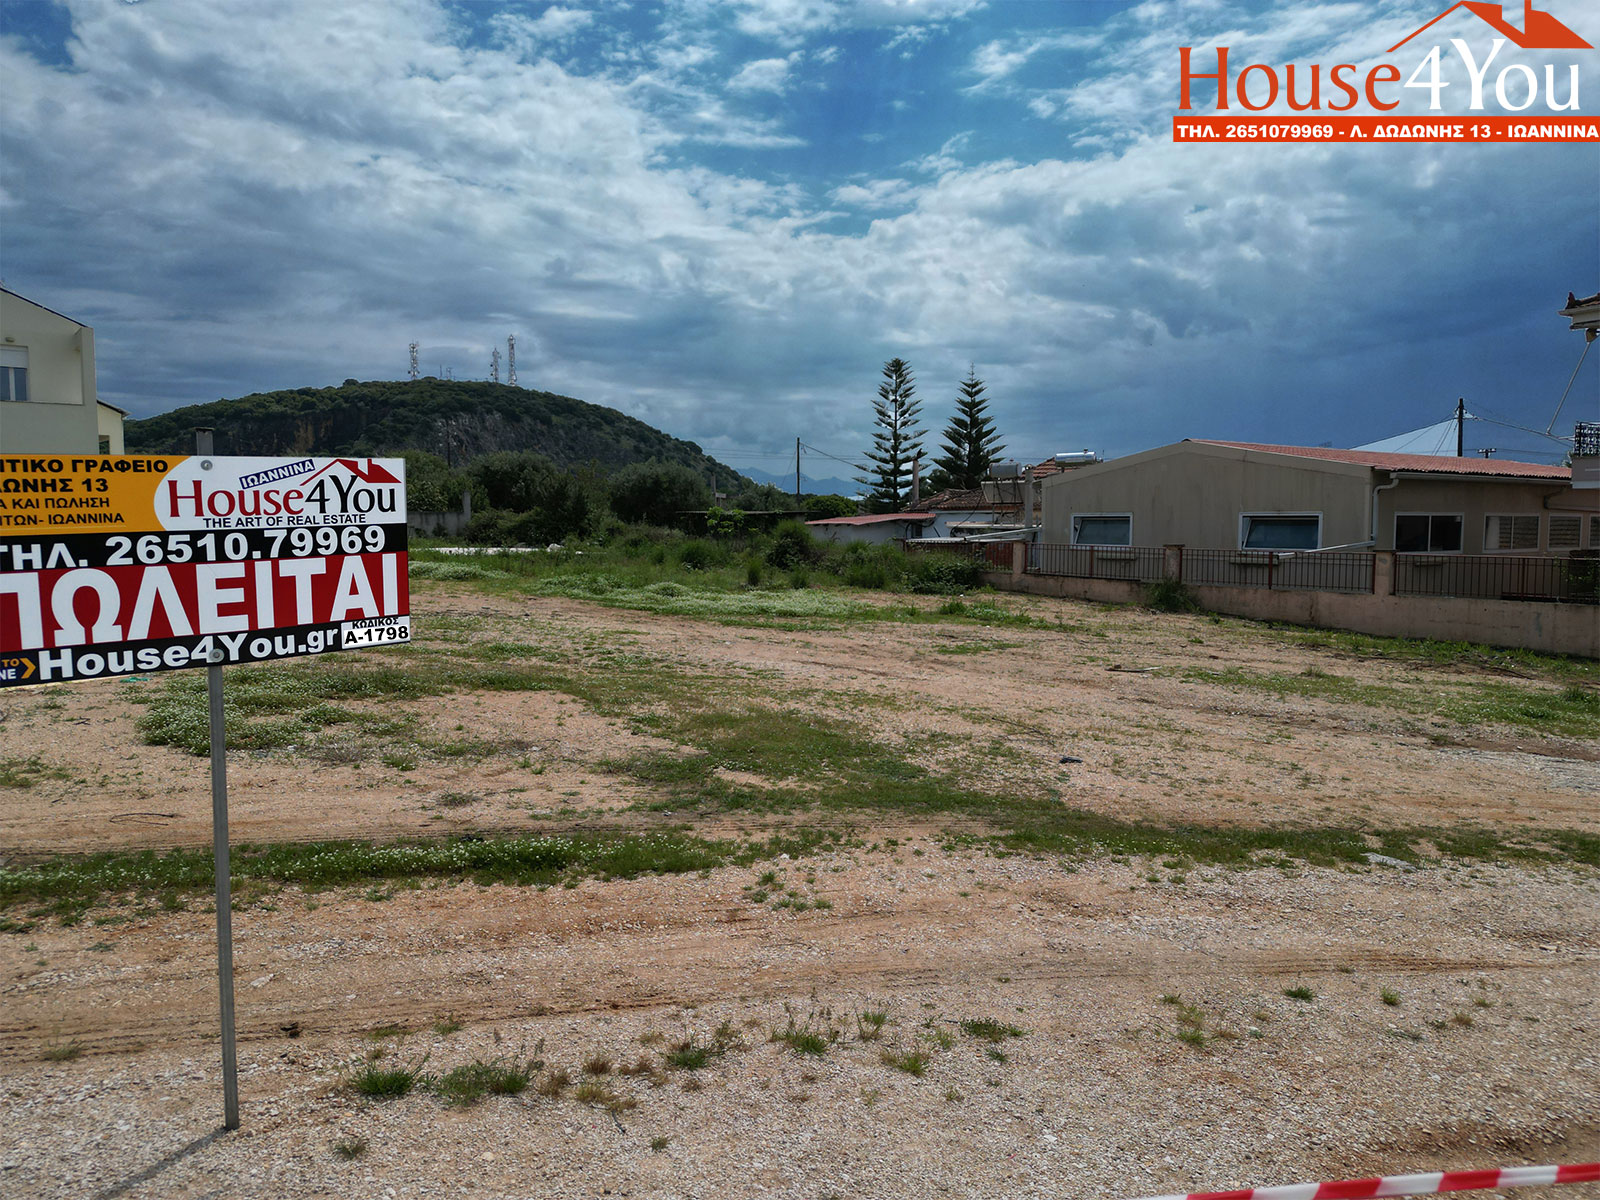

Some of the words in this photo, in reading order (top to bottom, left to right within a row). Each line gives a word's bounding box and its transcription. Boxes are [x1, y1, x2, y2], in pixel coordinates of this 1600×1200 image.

[71, 459, 168, 473] ΓΡΑΦΕΙΟ
[242, 461, 314, 488] ΙΩΑΝΝΙΝΑ
[0, 478, 73, 493] ΩΝΗΣ
[82, 478, 109, 492] 13
[12, 498, 40, 509] ΚΑΙ
[45, 497, 110, 509] ΠΩΛΗΣΗ
[167, 474, 396, 518] House4You
[48, 513, 125, 525] ΙΩΑΝΝΙΝΑ
[203, 517, 231, 528] THE
[235, 516, 262, 527] ART
[266, 516, 283, 526] OF
[287, 514, 319, 525] REAL
[323, 513, 366, 524] ESTATE
[105, 525, 385, 566] 26510.79969
[352, 616, 399, 630] ΚΩΔΙΚΟΣ
[38, 627, 338, 681] House4You.gr
